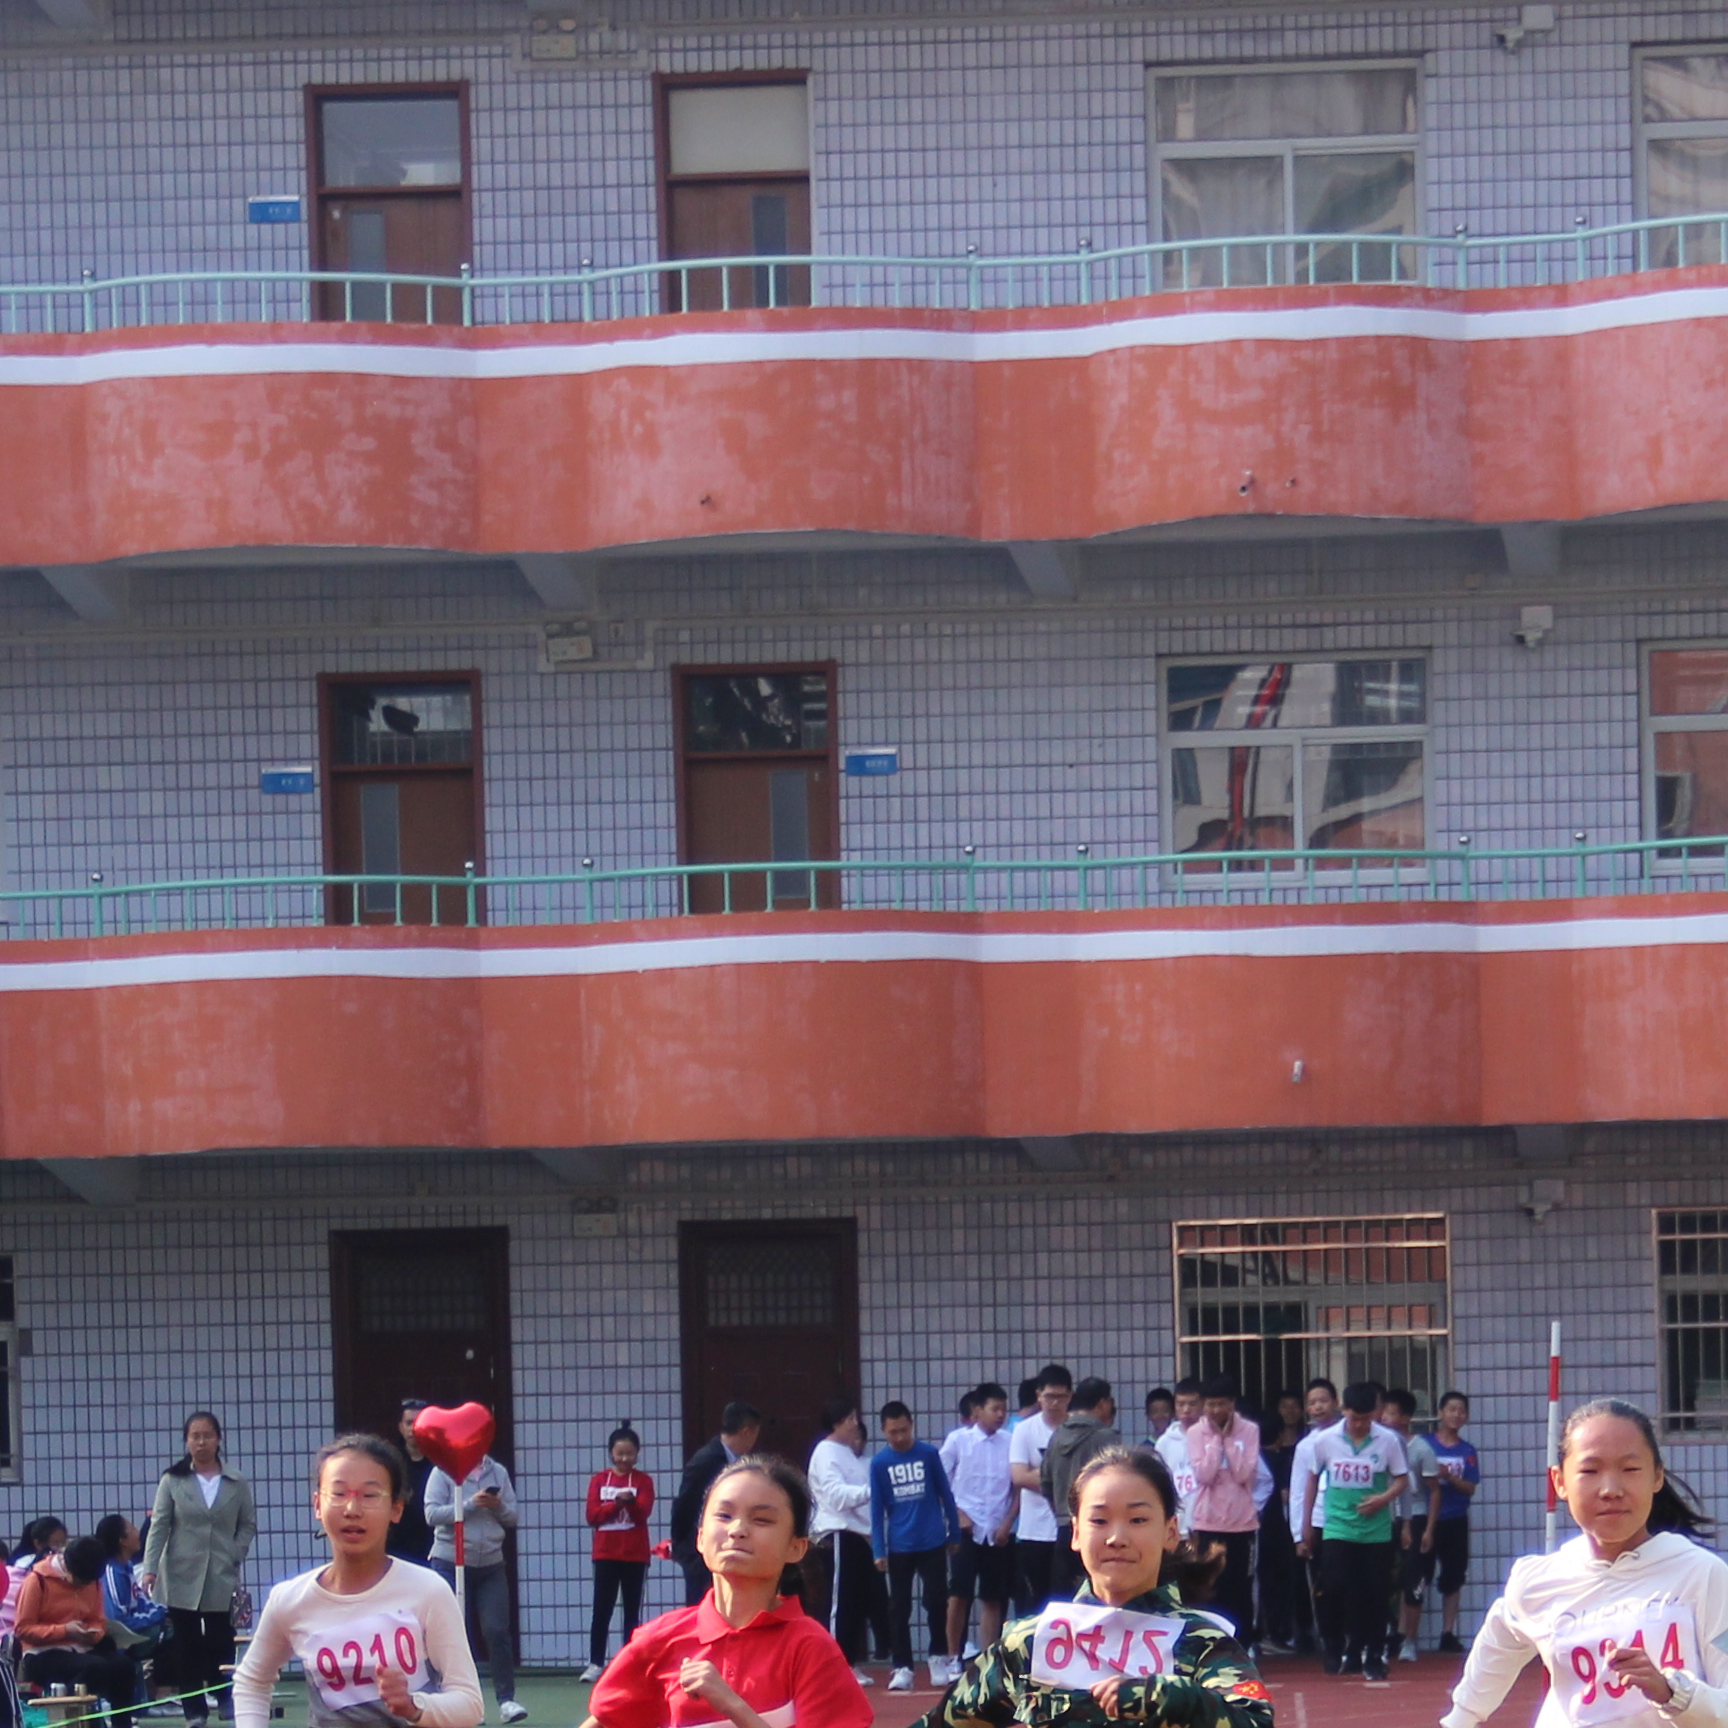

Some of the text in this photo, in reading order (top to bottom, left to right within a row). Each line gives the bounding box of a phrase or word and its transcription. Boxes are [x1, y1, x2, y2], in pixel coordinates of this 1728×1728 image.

[887, 1460, 926, 1485] 1916
[1333, 1463, 1371, 1483] 7613
[316, 1625, 419, 1693] 9210
